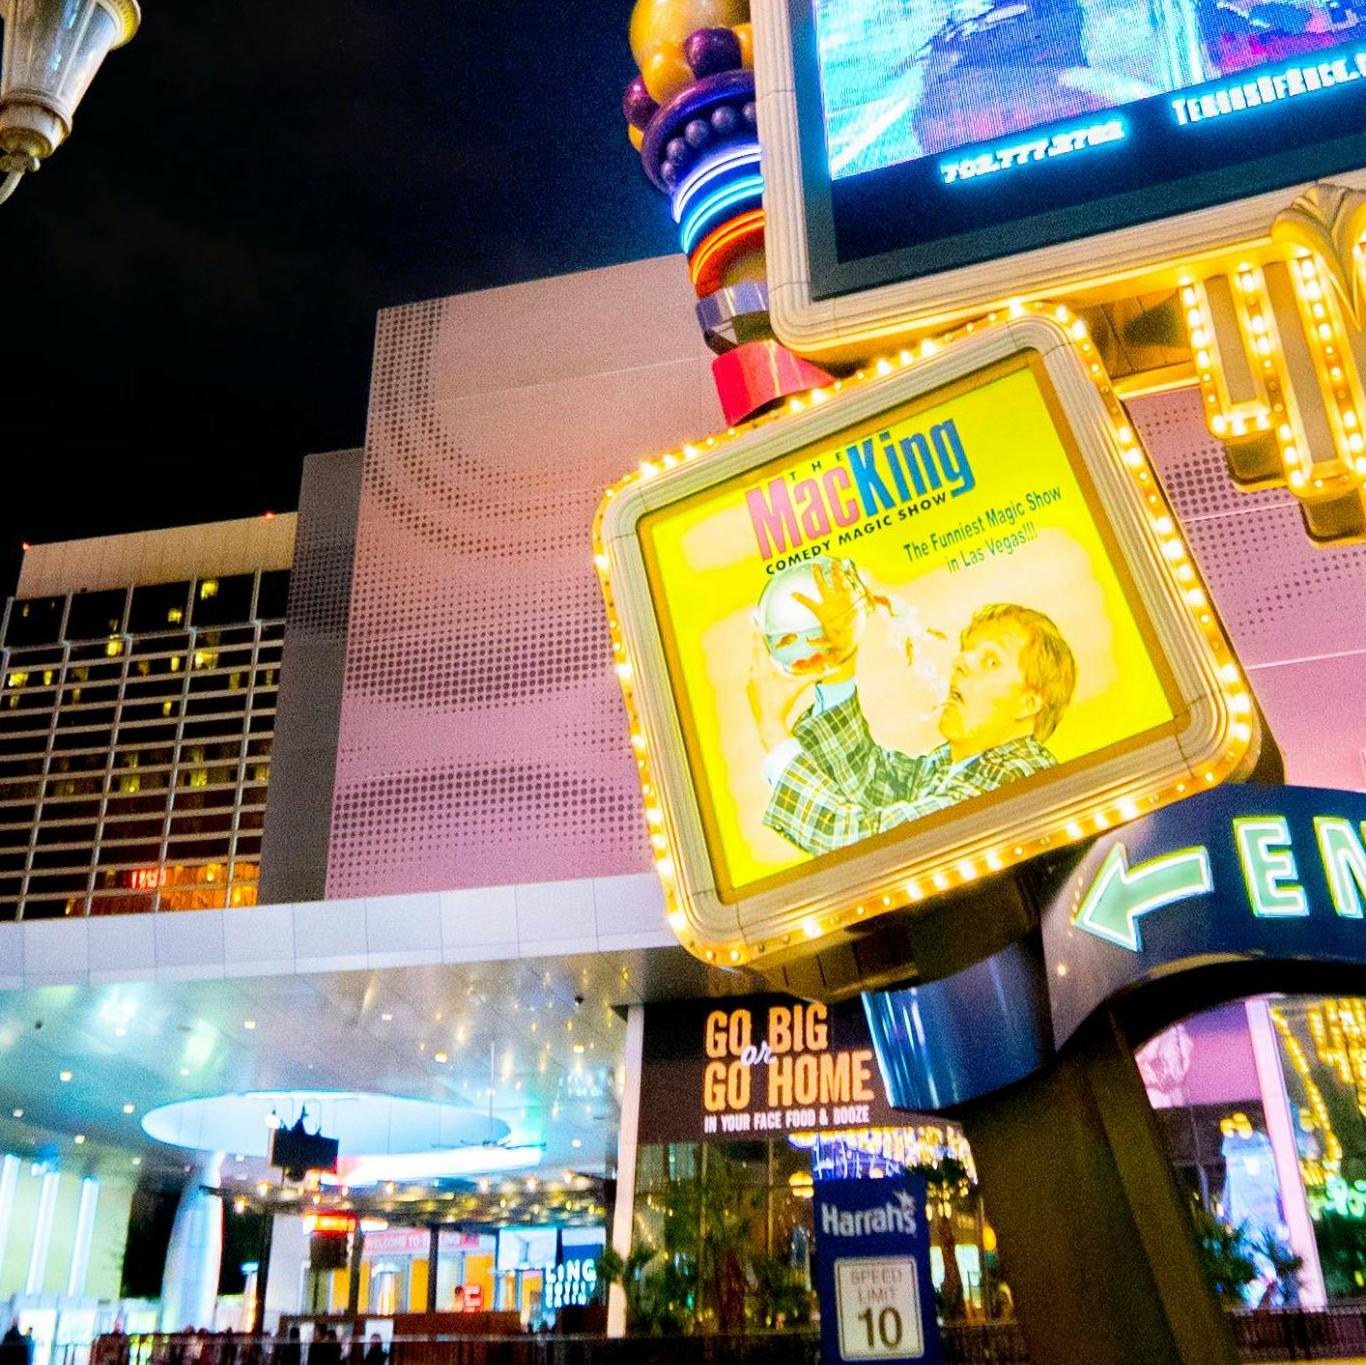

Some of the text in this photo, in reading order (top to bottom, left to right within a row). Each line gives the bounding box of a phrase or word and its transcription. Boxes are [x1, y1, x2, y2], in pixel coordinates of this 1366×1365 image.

[790, 451, 845, 482] THE
[765, 491, 948, 575] COMEDY MAGIC SHOW
[903, 486, 1063, 563] The Funniest Magic Show
[947, 521, 1039, 574] in Las Vegas!!!
[706, 1003, 828, 1059] GO BIG
[739, 1040, 778, 1066] or
[704, 1049, 875, 1112] GO HOME
[704, 1115, 718, 1134] IN
[721, 1112, 751, 1133] YOUR
[753, 1110, 782, 1131] FACE
[786, 1108, 816, 1128] FOOD
[833, 1105, 871, 1125] BOOZE
[821, 1190, 917, 1236] Harrah's
[850, 1268, 903, 1285] SPEED
[857, 1286, 897, 1303] LIMIT
[858, 1305, 904, 1351] 10
